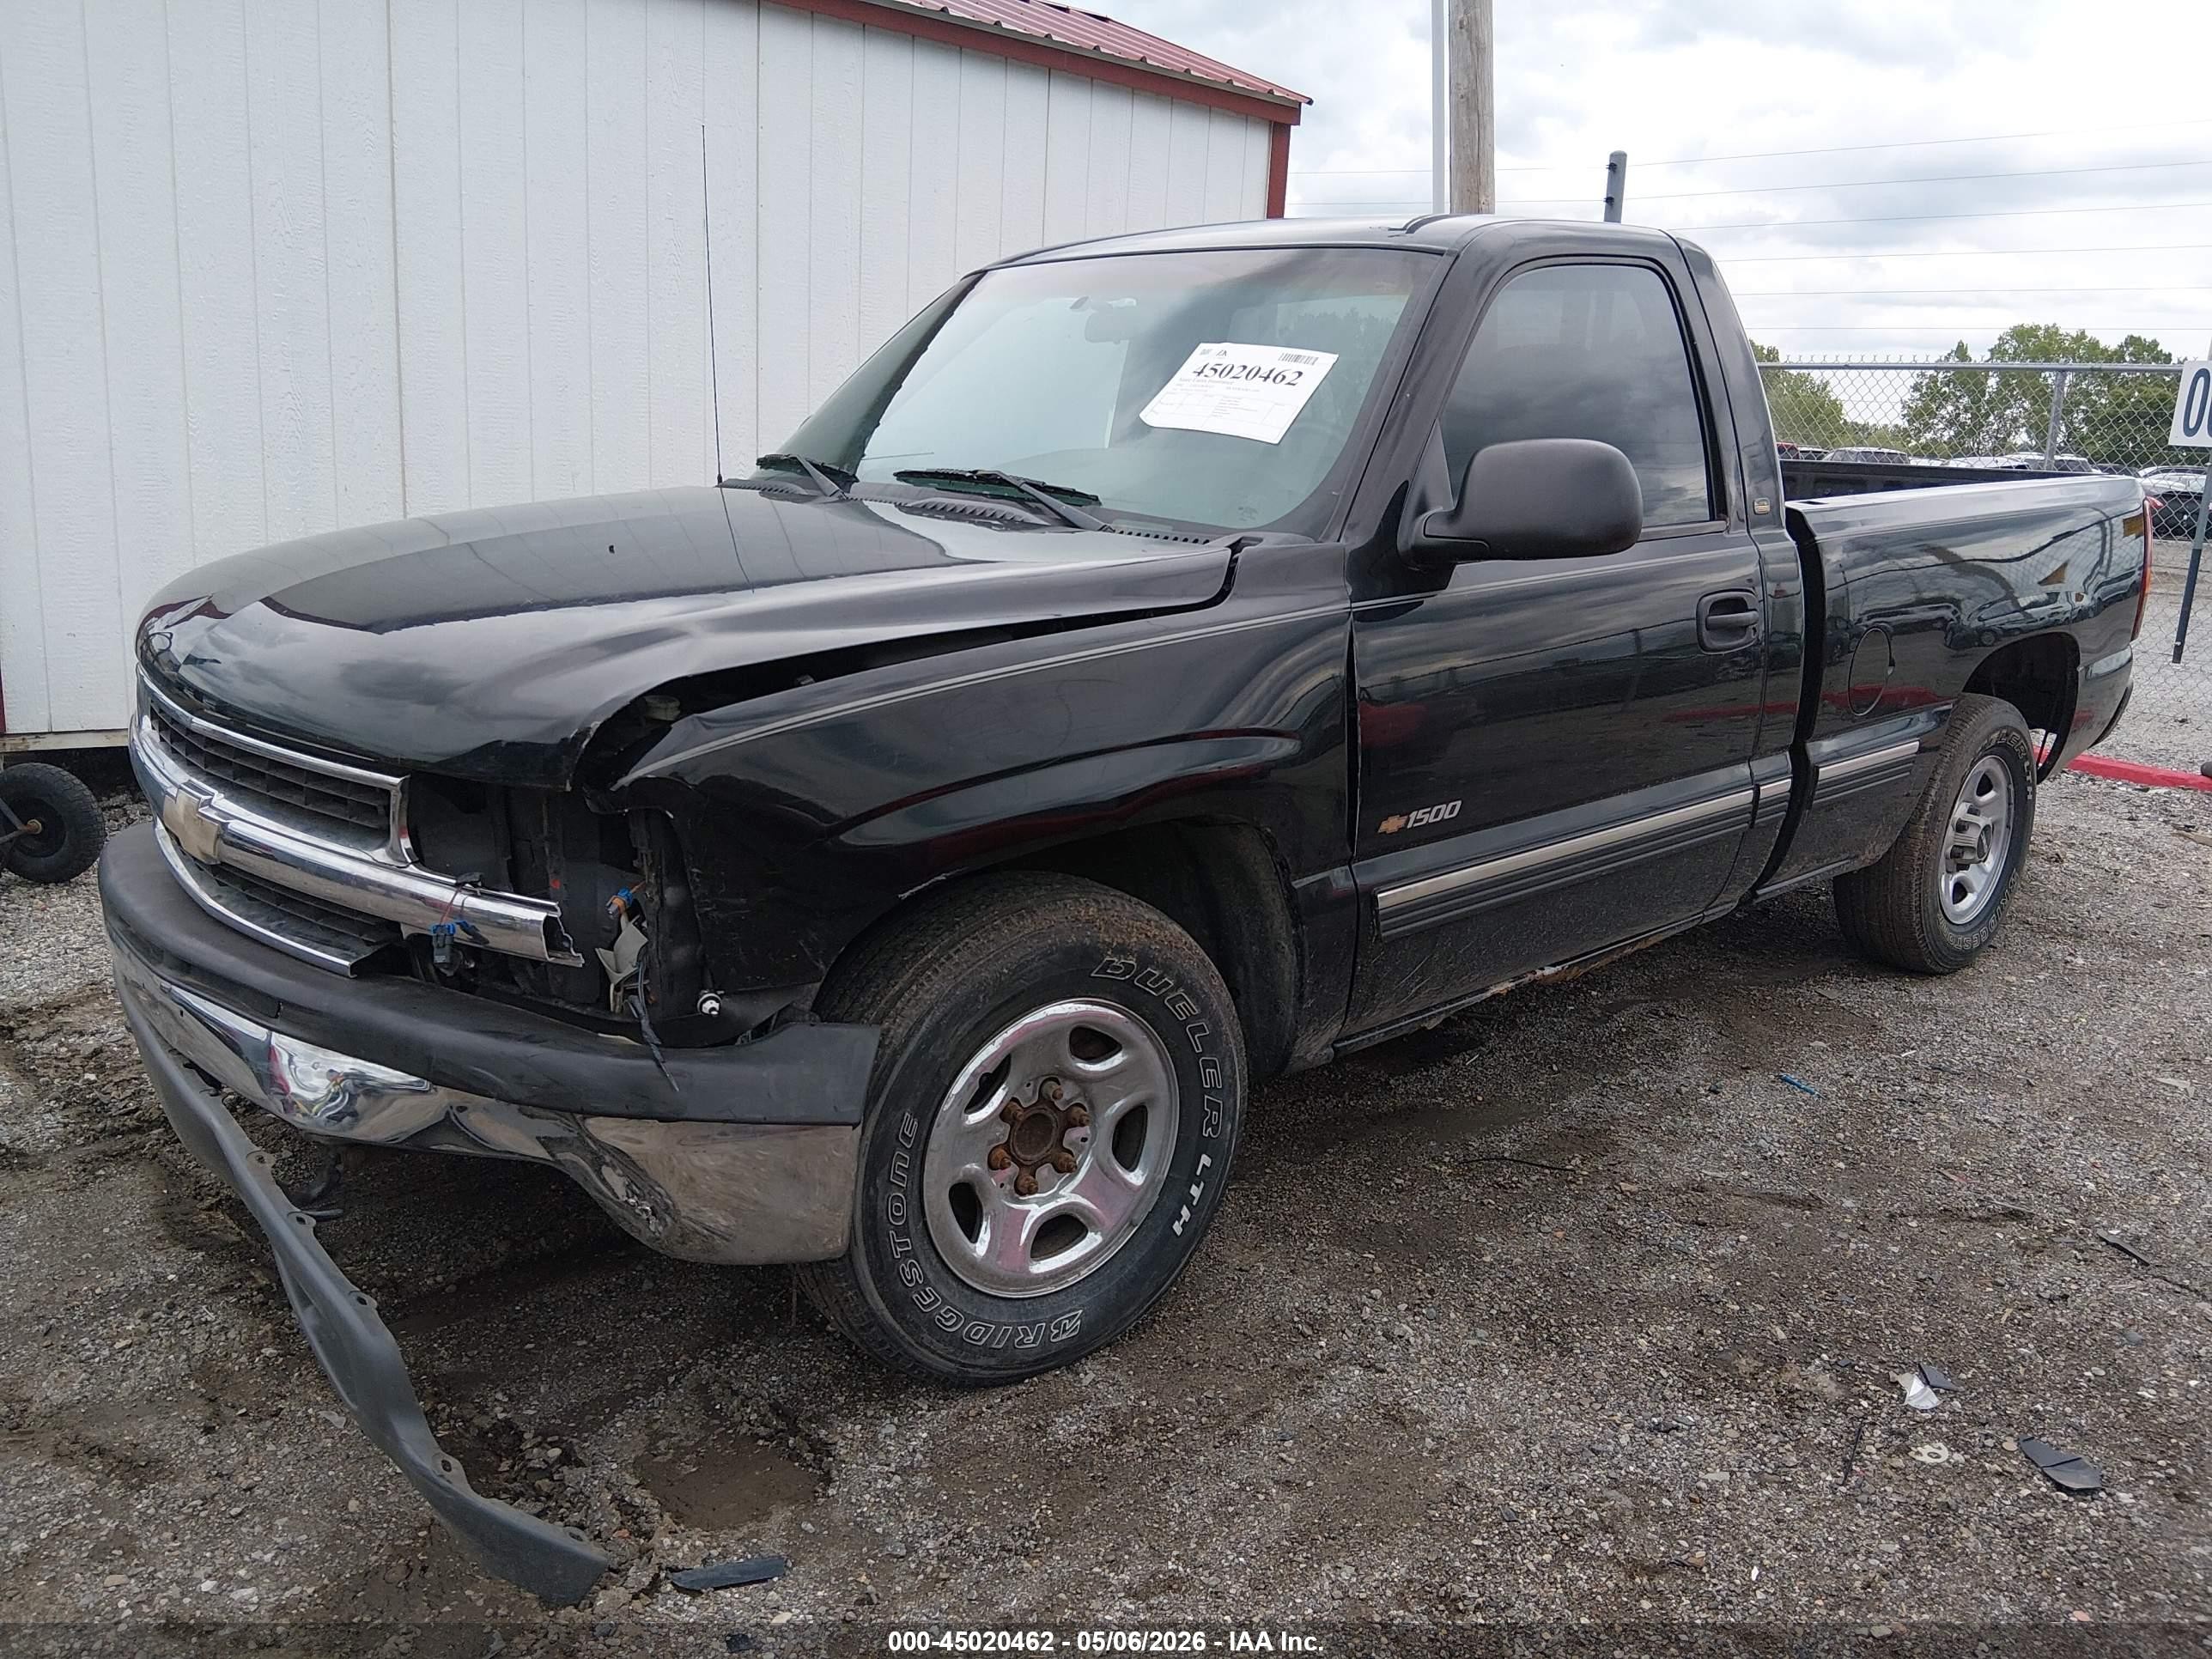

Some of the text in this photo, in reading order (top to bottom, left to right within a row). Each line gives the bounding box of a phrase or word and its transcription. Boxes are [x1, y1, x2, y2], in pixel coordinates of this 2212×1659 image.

[1193, 362, 1304, 386] 45020462
[2183, 368, 2212, 437] 0
[1407, 799, 1462, 830] 1500
[1091, 957, 1223, 1139] DUELER
[885, 1110, 1085, 1350] BRIDGESTONE
